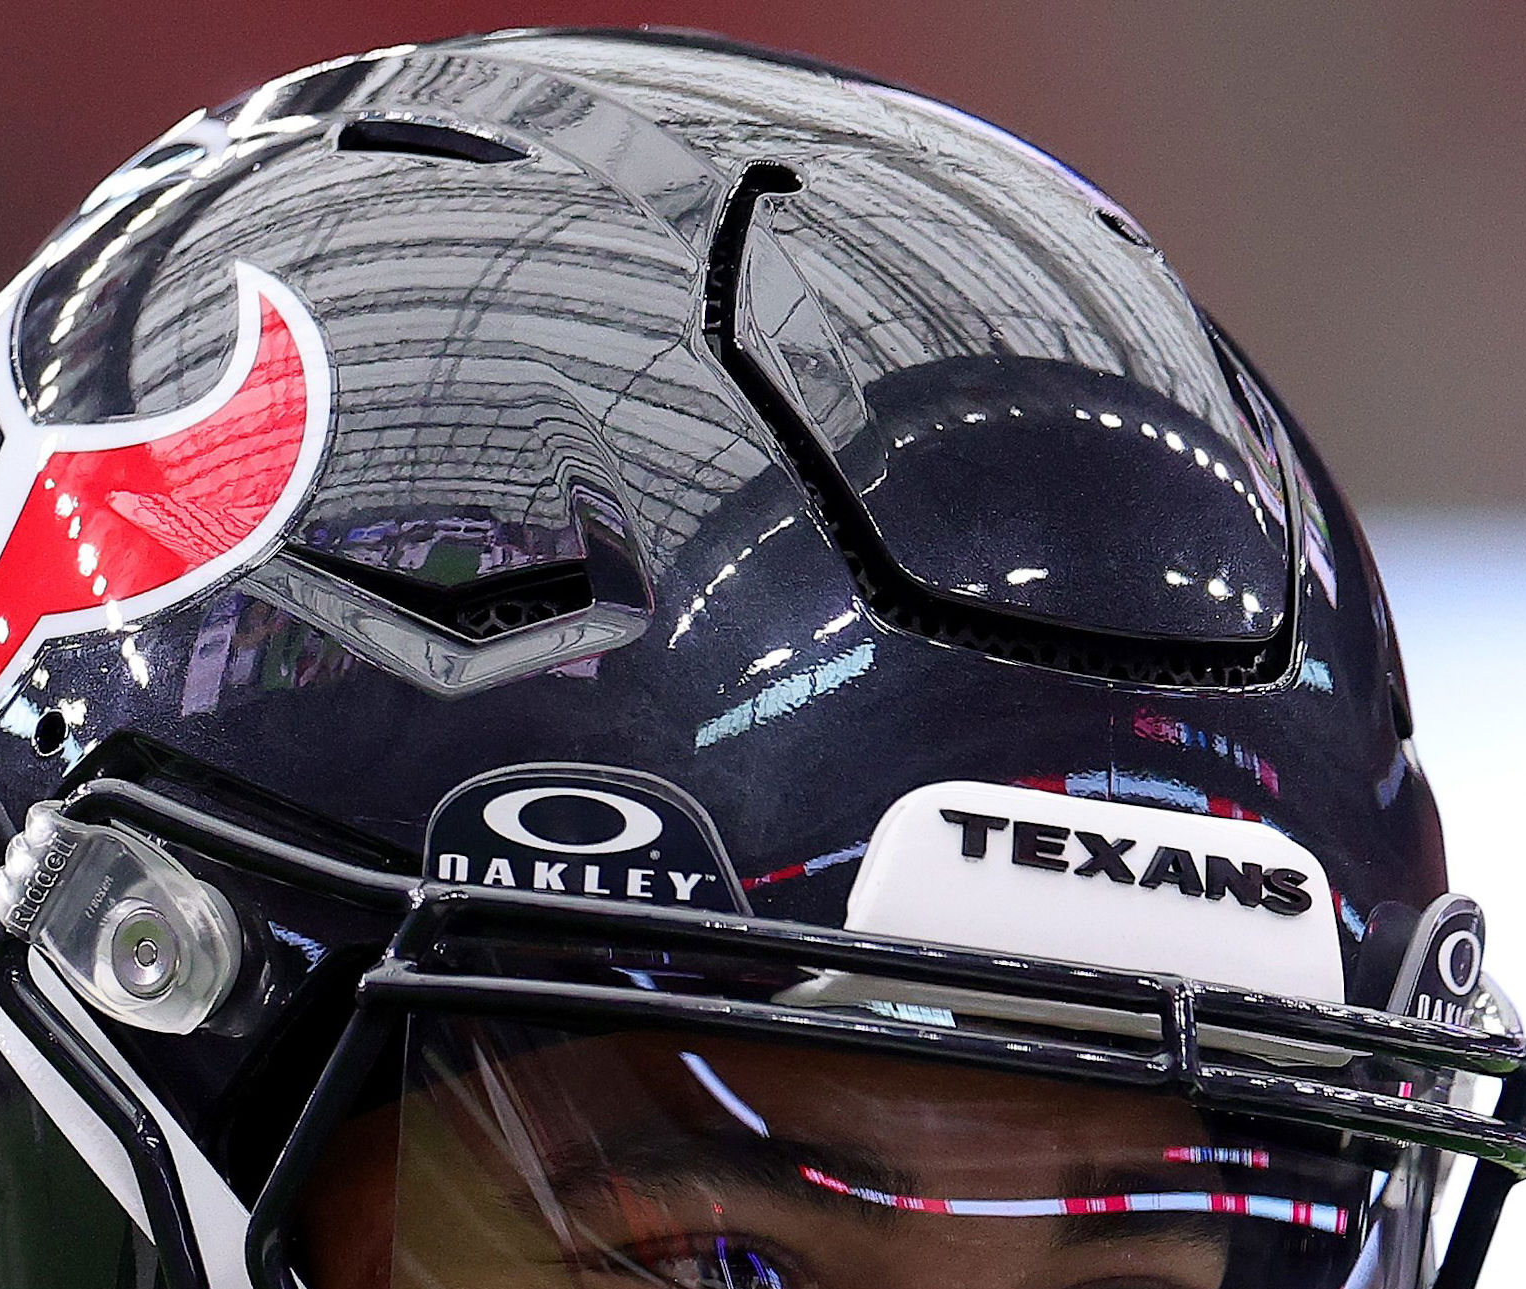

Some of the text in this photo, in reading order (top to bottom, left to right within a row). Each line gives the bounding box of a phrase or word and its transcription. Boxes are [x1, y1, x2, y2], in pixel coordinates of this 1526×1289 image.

[4, 831, 78, 932] Riddell
[438, 853, 703, 901] OAKLEY
[939, 808, 1313, 917] TEXANS
